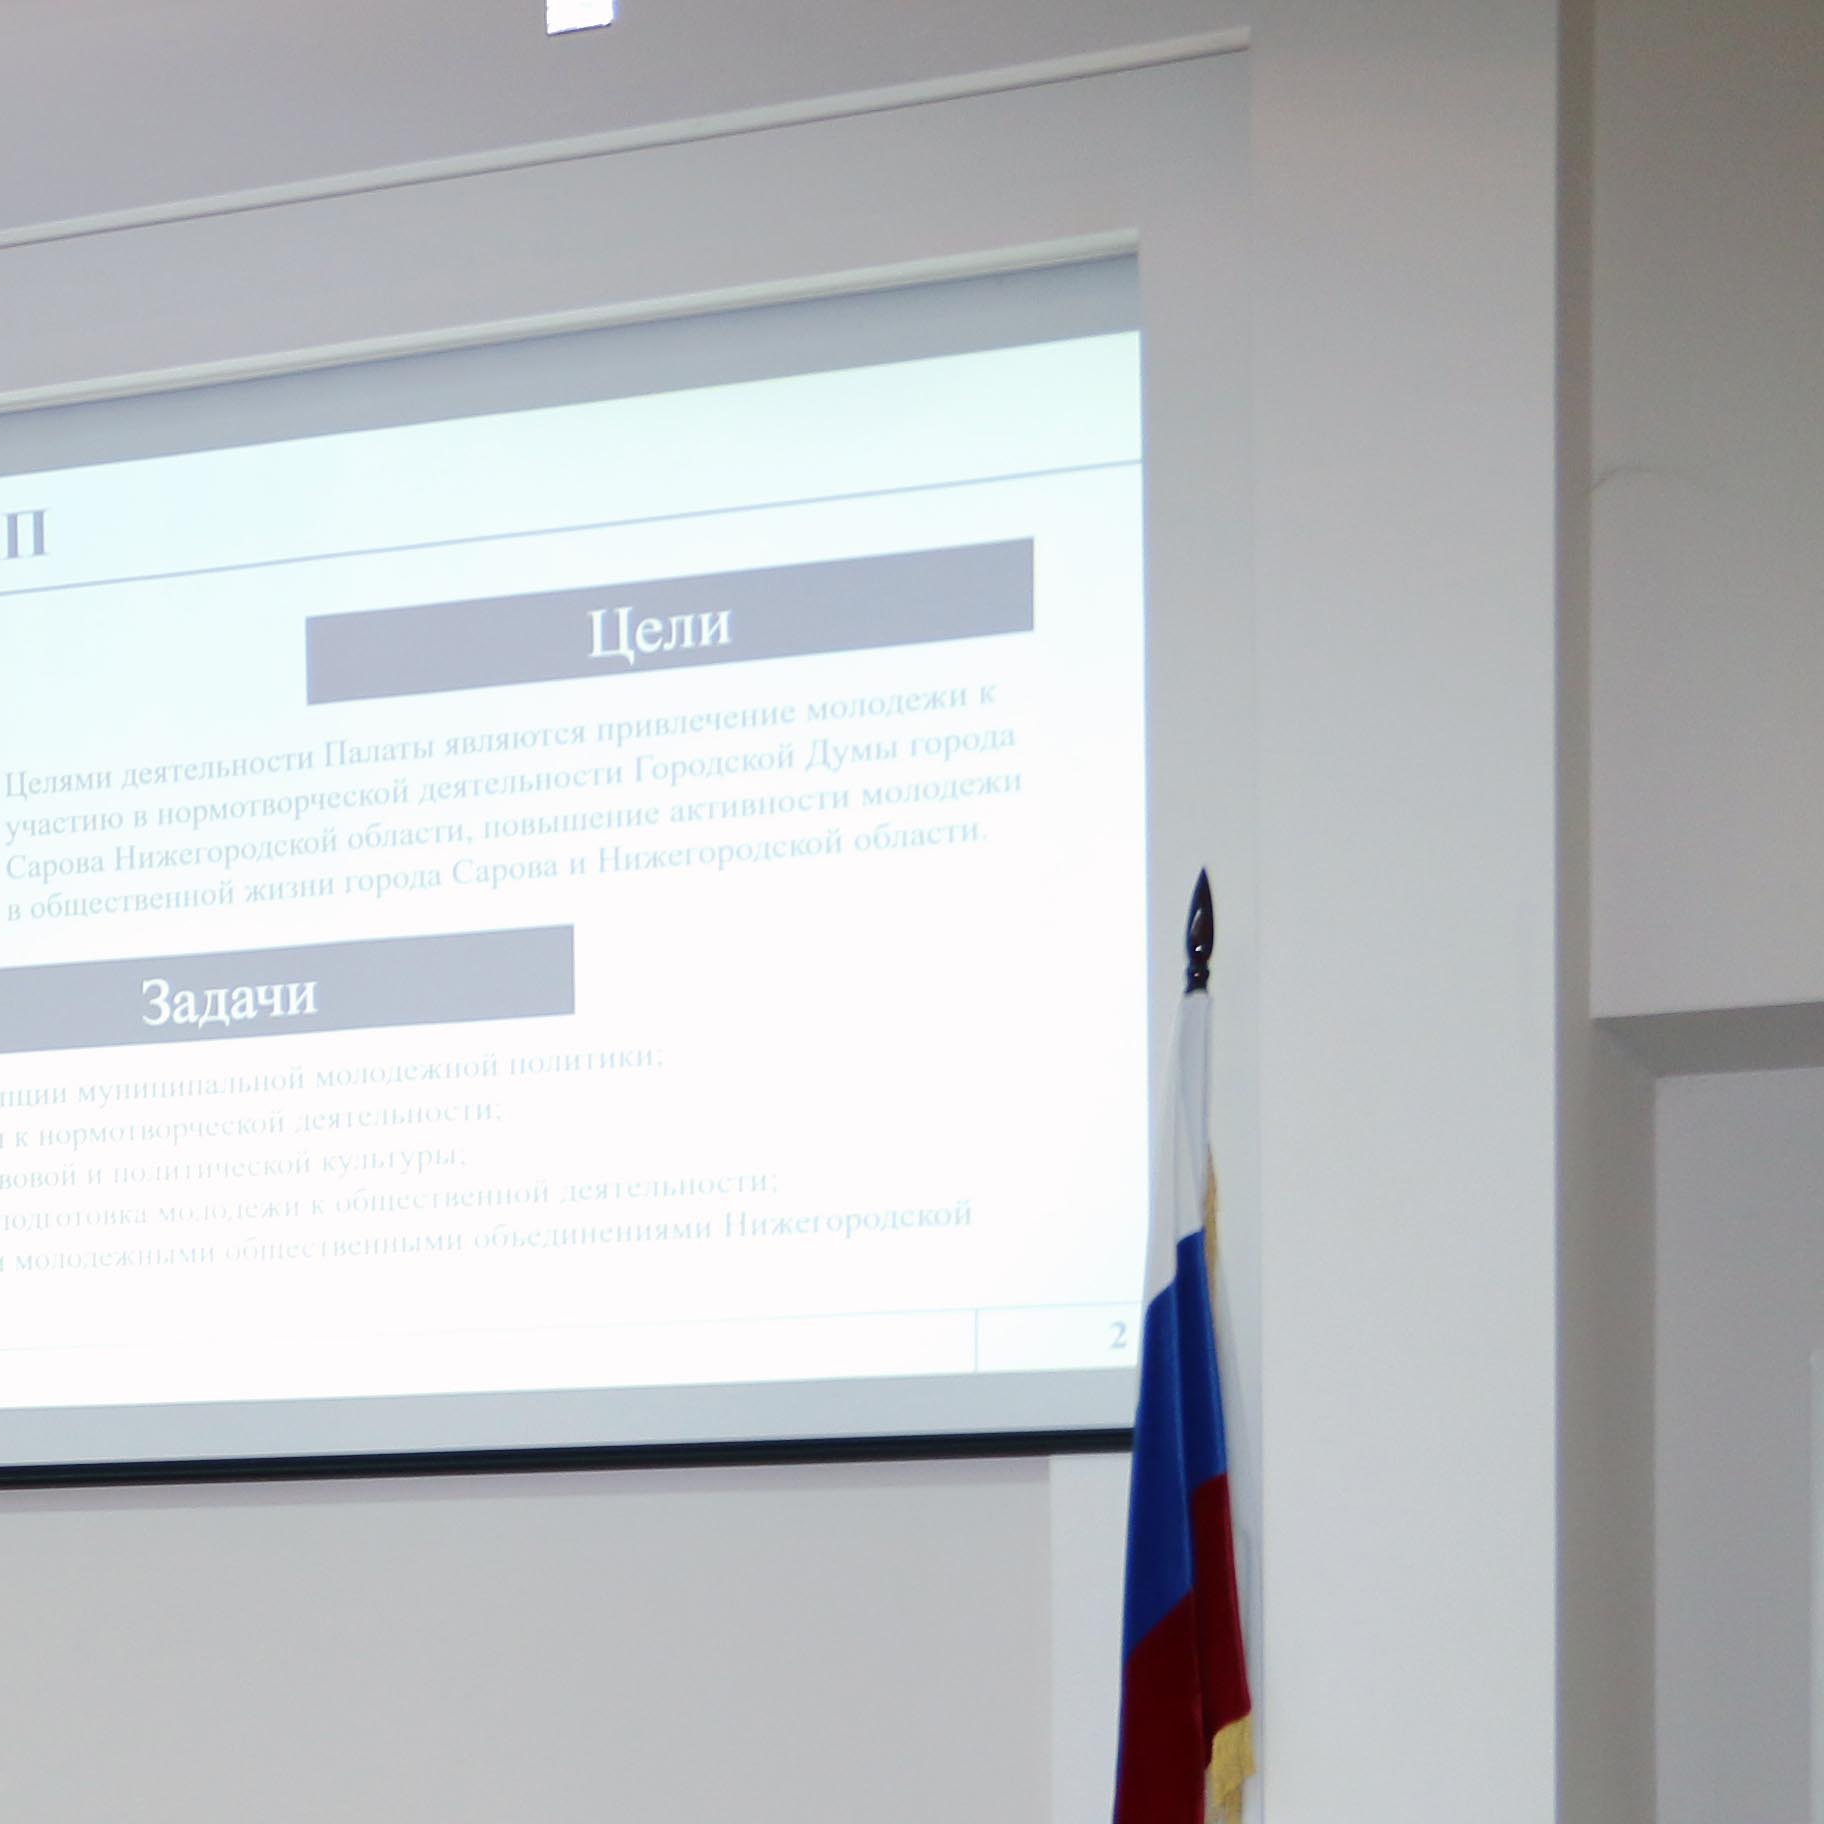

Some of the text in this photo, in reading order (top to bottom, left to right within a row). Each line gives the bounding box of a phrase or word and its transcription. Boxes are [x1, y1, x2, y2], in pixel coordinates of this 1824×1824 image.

[587, 606, 733, 665] Цели
[4, 683, 999, 799] Целями деятельности Палаты являются привлечение молодежи к
[4, 727, 1016, 846] участию в нормотворческой деятельности Городской Думы города
[6, 773, 1023, 884] Сарова Нижегородской области, повышение активности молодежи
[7, 820, 988, 922] в общественной жизни города Сарова и Нижегородской области.
[142, 978, 319, 1028] Задачи
[78, 1070, 304, 1107] муниципальной
[316, 1055, 497, 1089] молодежной
[16, 1131, 28, 1149] к
[39, 1111, 284, 1150] нормотворческой
[88, 1168, 102, 1185] и
[311, 1198, 325, 1216] к
[725, 1200, 973, 1241] Нижегородской
[1109, 1320, 1127, 1349] 2
